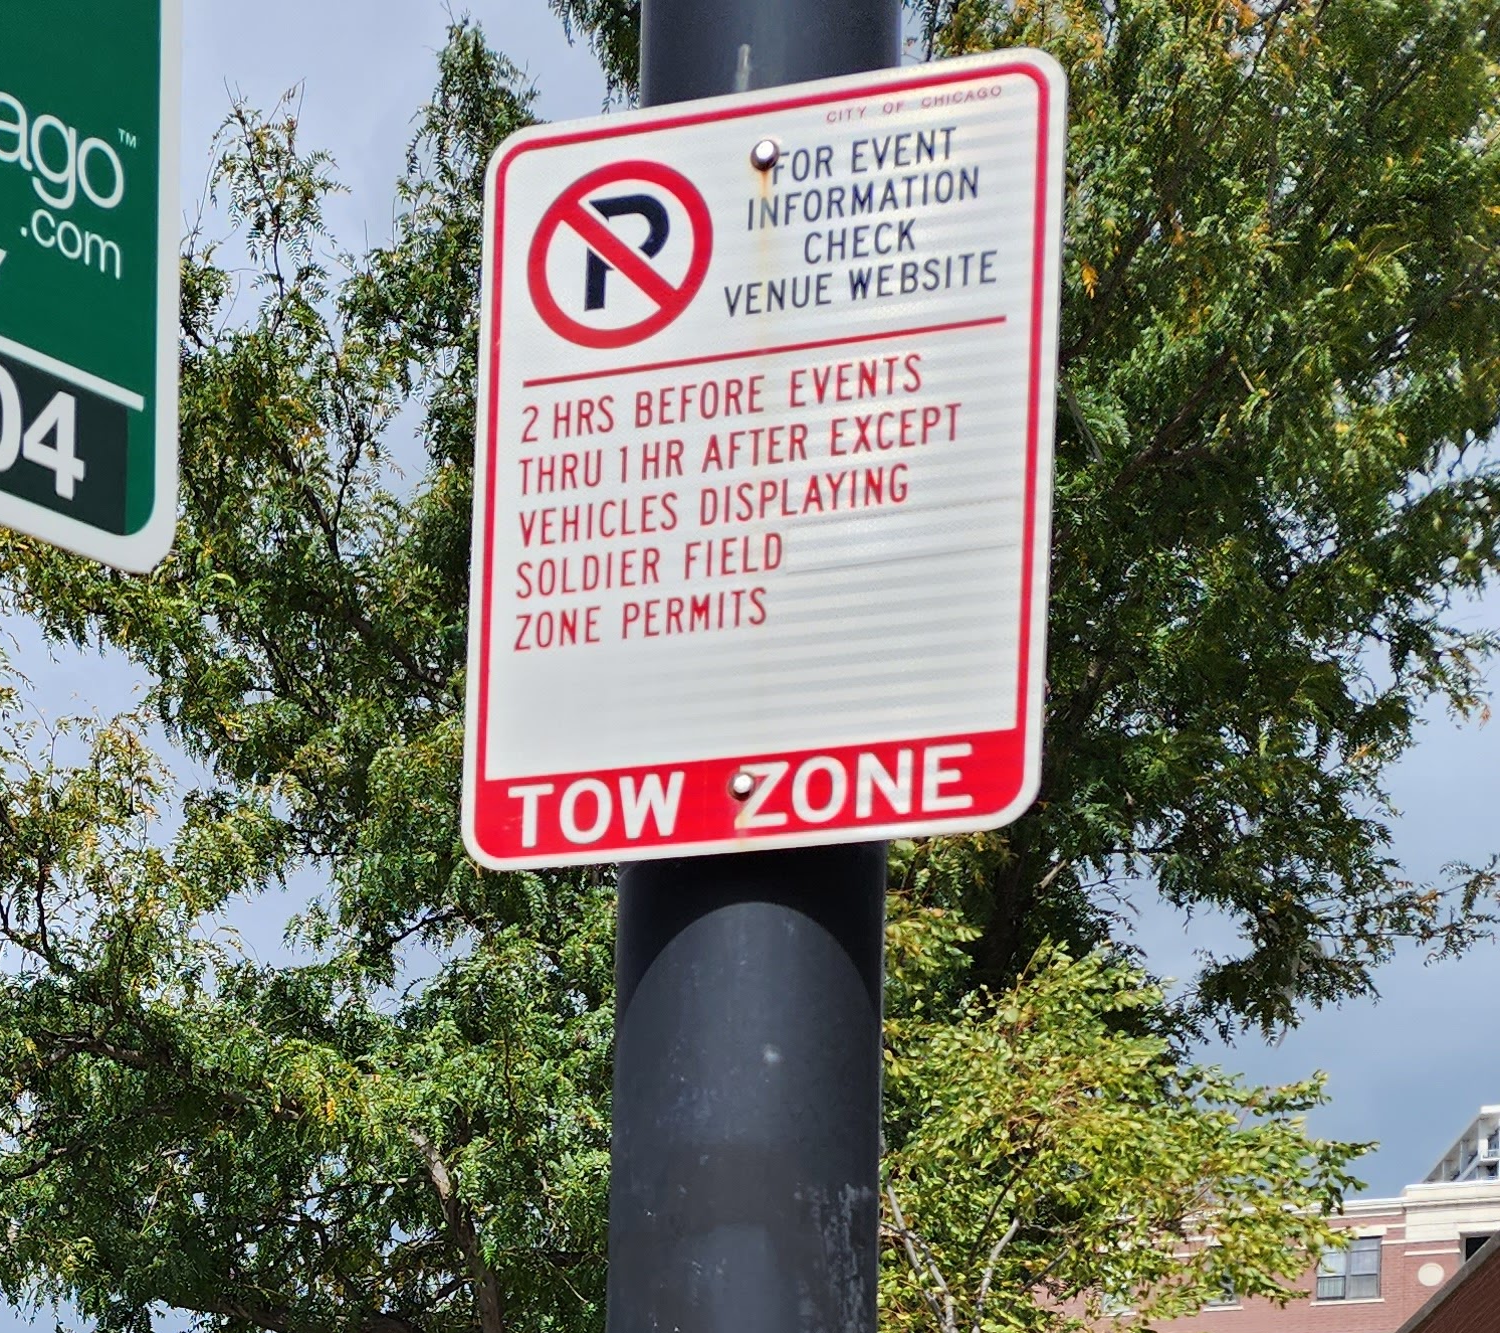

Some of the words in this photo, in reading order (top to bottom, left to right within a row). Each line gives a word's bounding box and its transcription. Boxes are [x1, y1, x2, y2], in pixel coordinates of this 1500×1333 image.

[826, 106, 867, 123] CITY
[882, 102, 904, 114] OF
[921, 85, 1002, 109] CHICAGO
[771, 146, 832, 187] FOR
[852, 126, 957, 174] EVENT
[747, 166, 979, 231] INFORMATION
[20, 209, 122, 280] .com
[803, 218, 916, 265] CHECK
[724, 272, 832, 317] VENUE
[848, 249, 999, 301] WEBSITE
[520, 405, 540, 444] 2
[552, 395, 615, 439] HRS
[634, 375, 766, 429] BEFORE
[789, 354, 923, 409] EVENTS
[518, 449, 603, 496] THRU
[619, 446, 628, 484] 1
[641, 438, 685, 480] HR
[701, 423, 808, 474] AFTER
[830, 402, 962, 458] EXCEPT
[518, 492, 678, 548] VEHICLES
[701, 463, 909, 527] DISPLAYING
[516, 547, 661, 600] SOLDIER
[684, 532, 783, 580] FIELD
[514, 606, 601, 652] ZONE
[621, 587, 767, 640] PERMITS
[508, 771, 685, 848] TOW
[734, 743, 974, 830] ZONE
